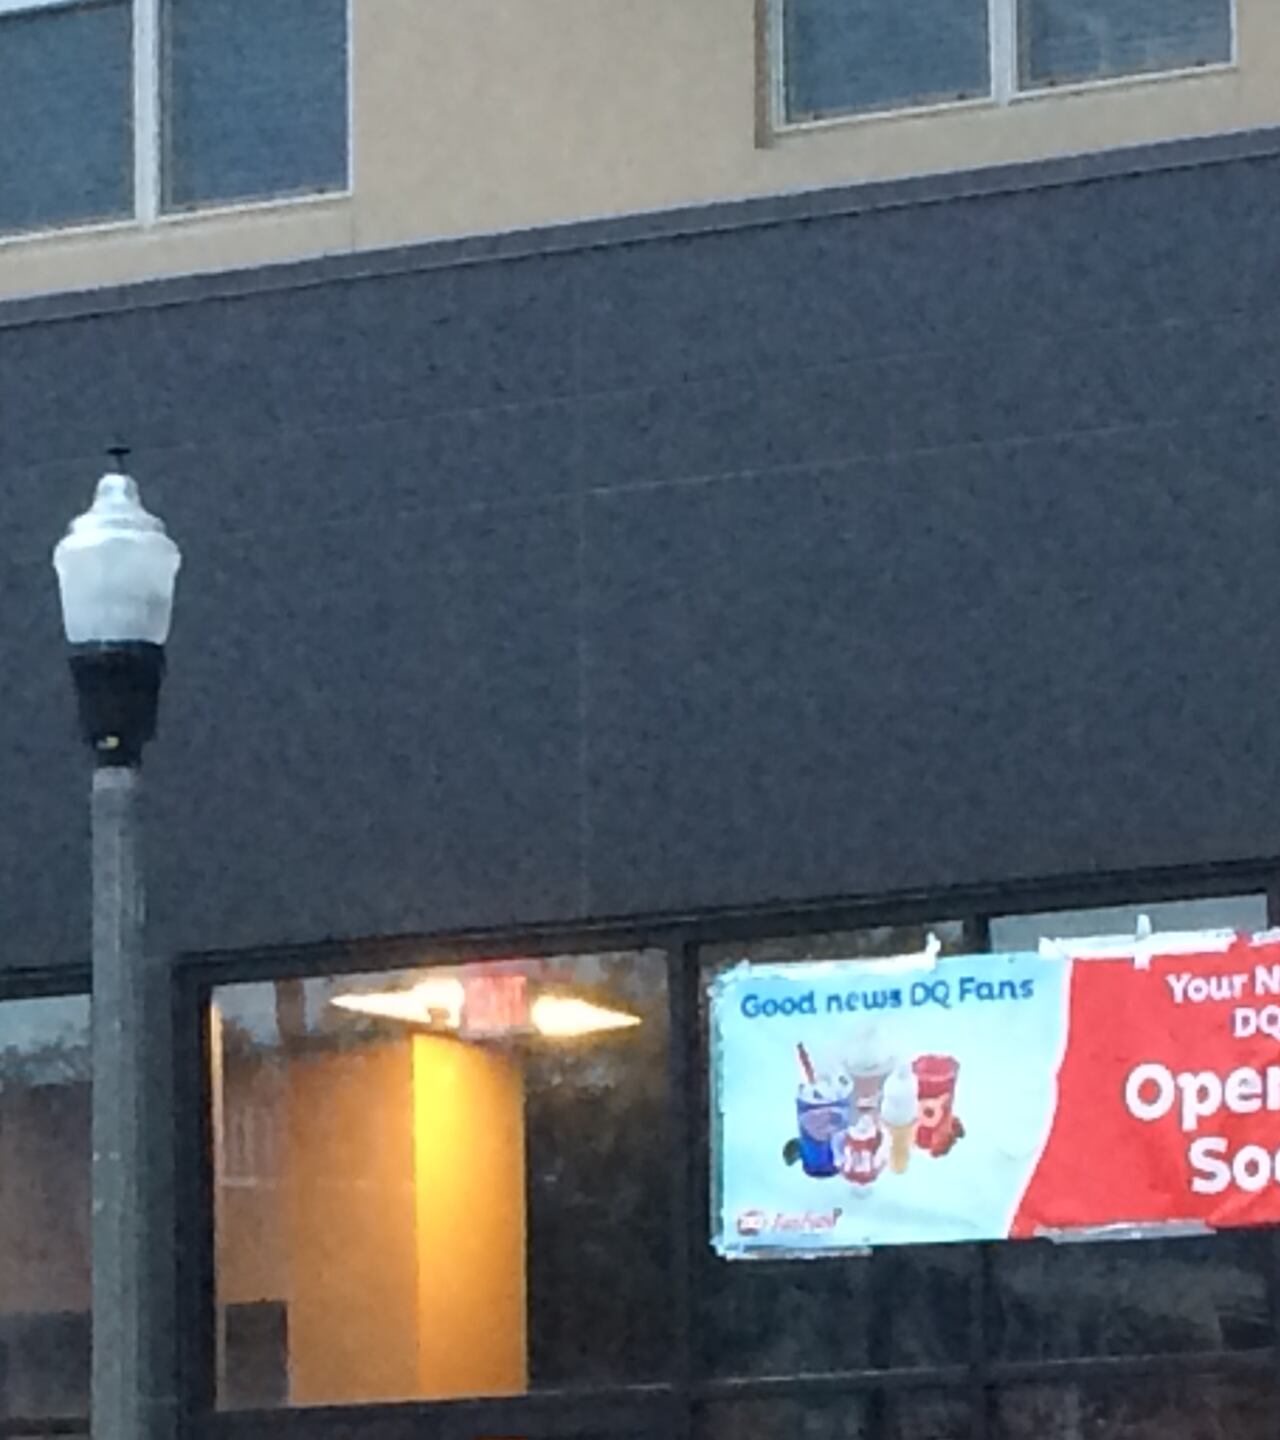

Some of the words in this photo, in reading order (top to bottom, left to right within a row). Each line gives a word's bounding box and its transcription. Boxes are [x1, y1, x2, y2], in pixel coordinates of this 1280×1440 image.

[740, 990, 817, 1019] Good
[826, 988, 903, 1013] news
[910, 980, 952, 1009] DQ
[959, 976, 1035, 1002] Fans
[1166, 972, 1248, 1004] Your
